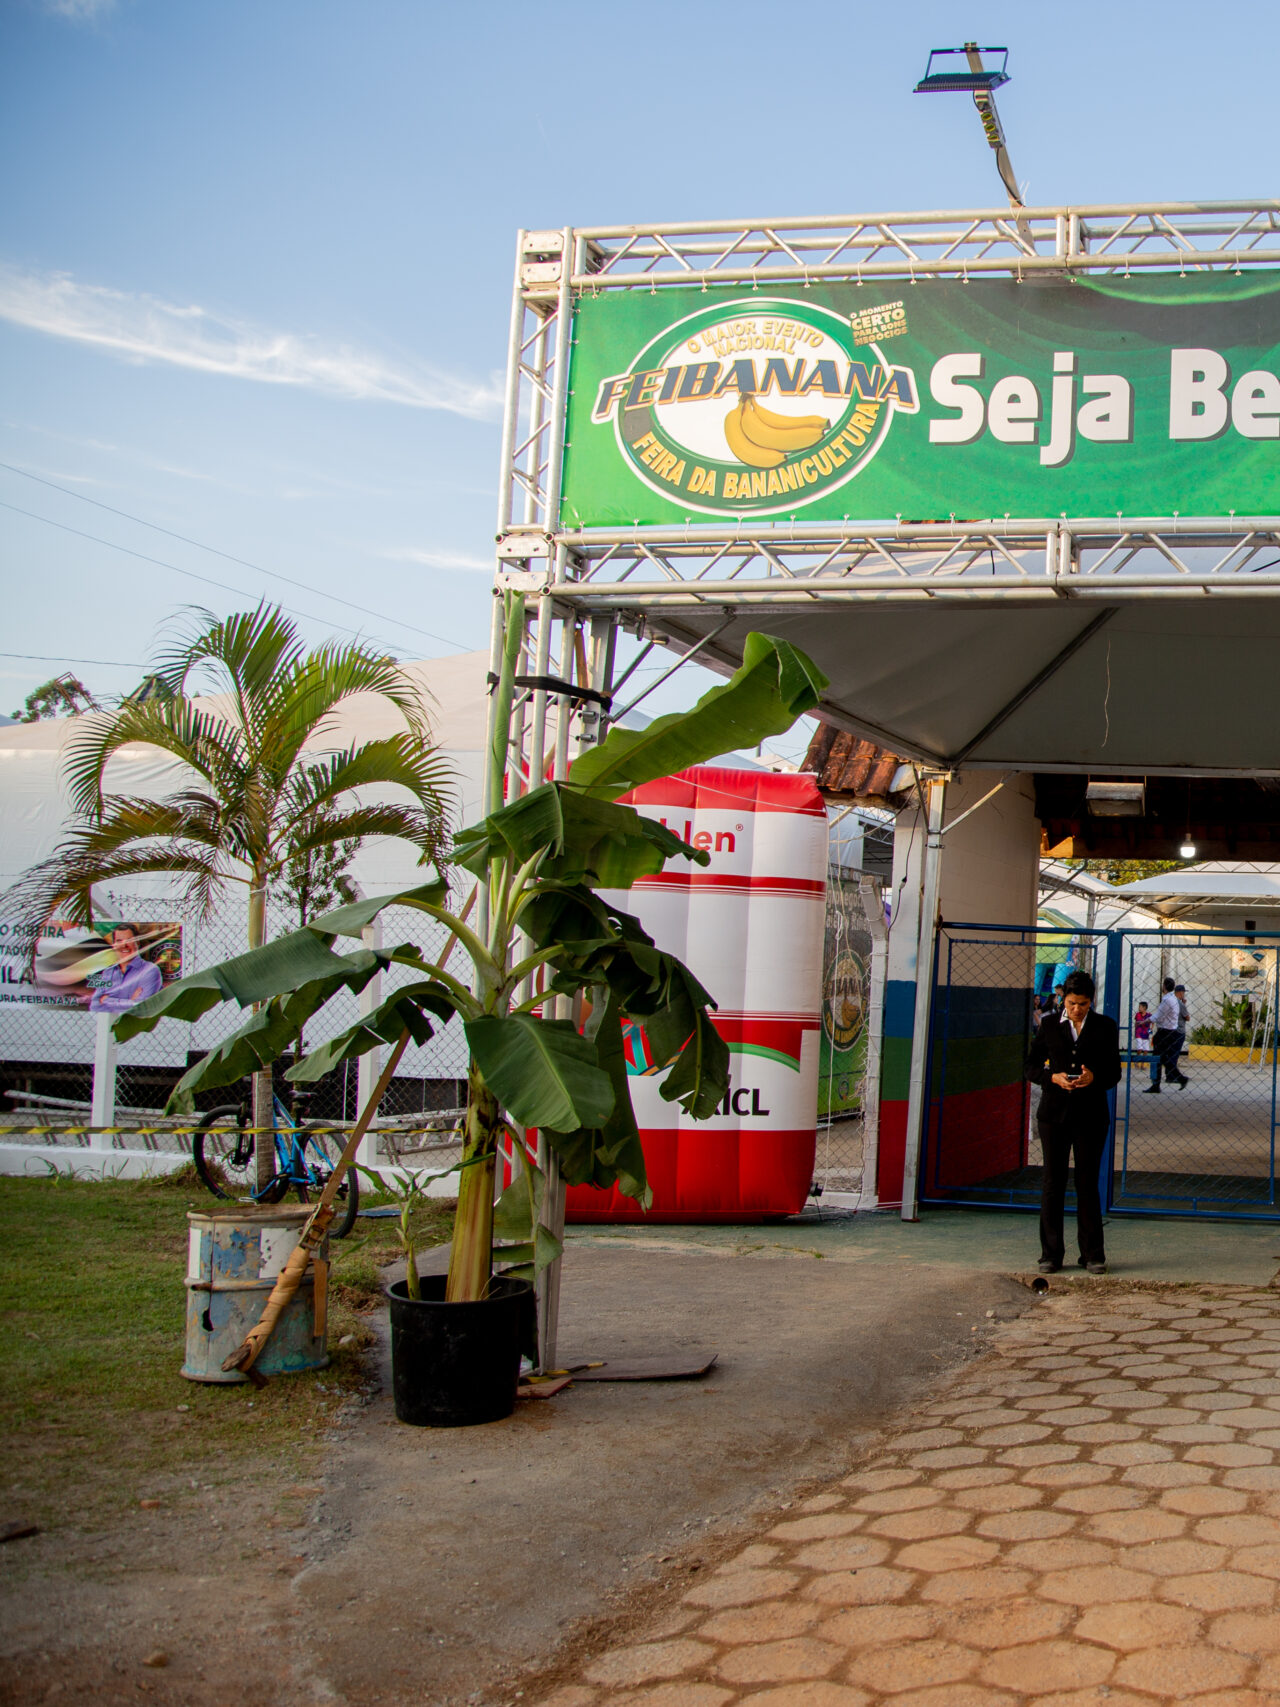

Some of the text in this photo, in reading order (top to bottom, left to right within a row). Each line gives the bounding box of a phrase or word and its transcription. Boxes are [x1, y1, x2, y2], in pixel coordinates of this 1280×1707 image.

[849, 300, 904, 320] O MOMENTO
[851, 307, 906, 331] CERTO
[687, 320, 825, 354] O MAIOR EVENTO
[853, 318, 907, 339] PARA BONS
[713, 335, 796, 359] NACIONAL
[595, 358, 915, 420] FEIBANANA
[929, 351, 1134, 466] Seja
[631, 403, 881, 500] FEIRA DA BANANICULTURA
[87, 980, 113, 988] AGRO
